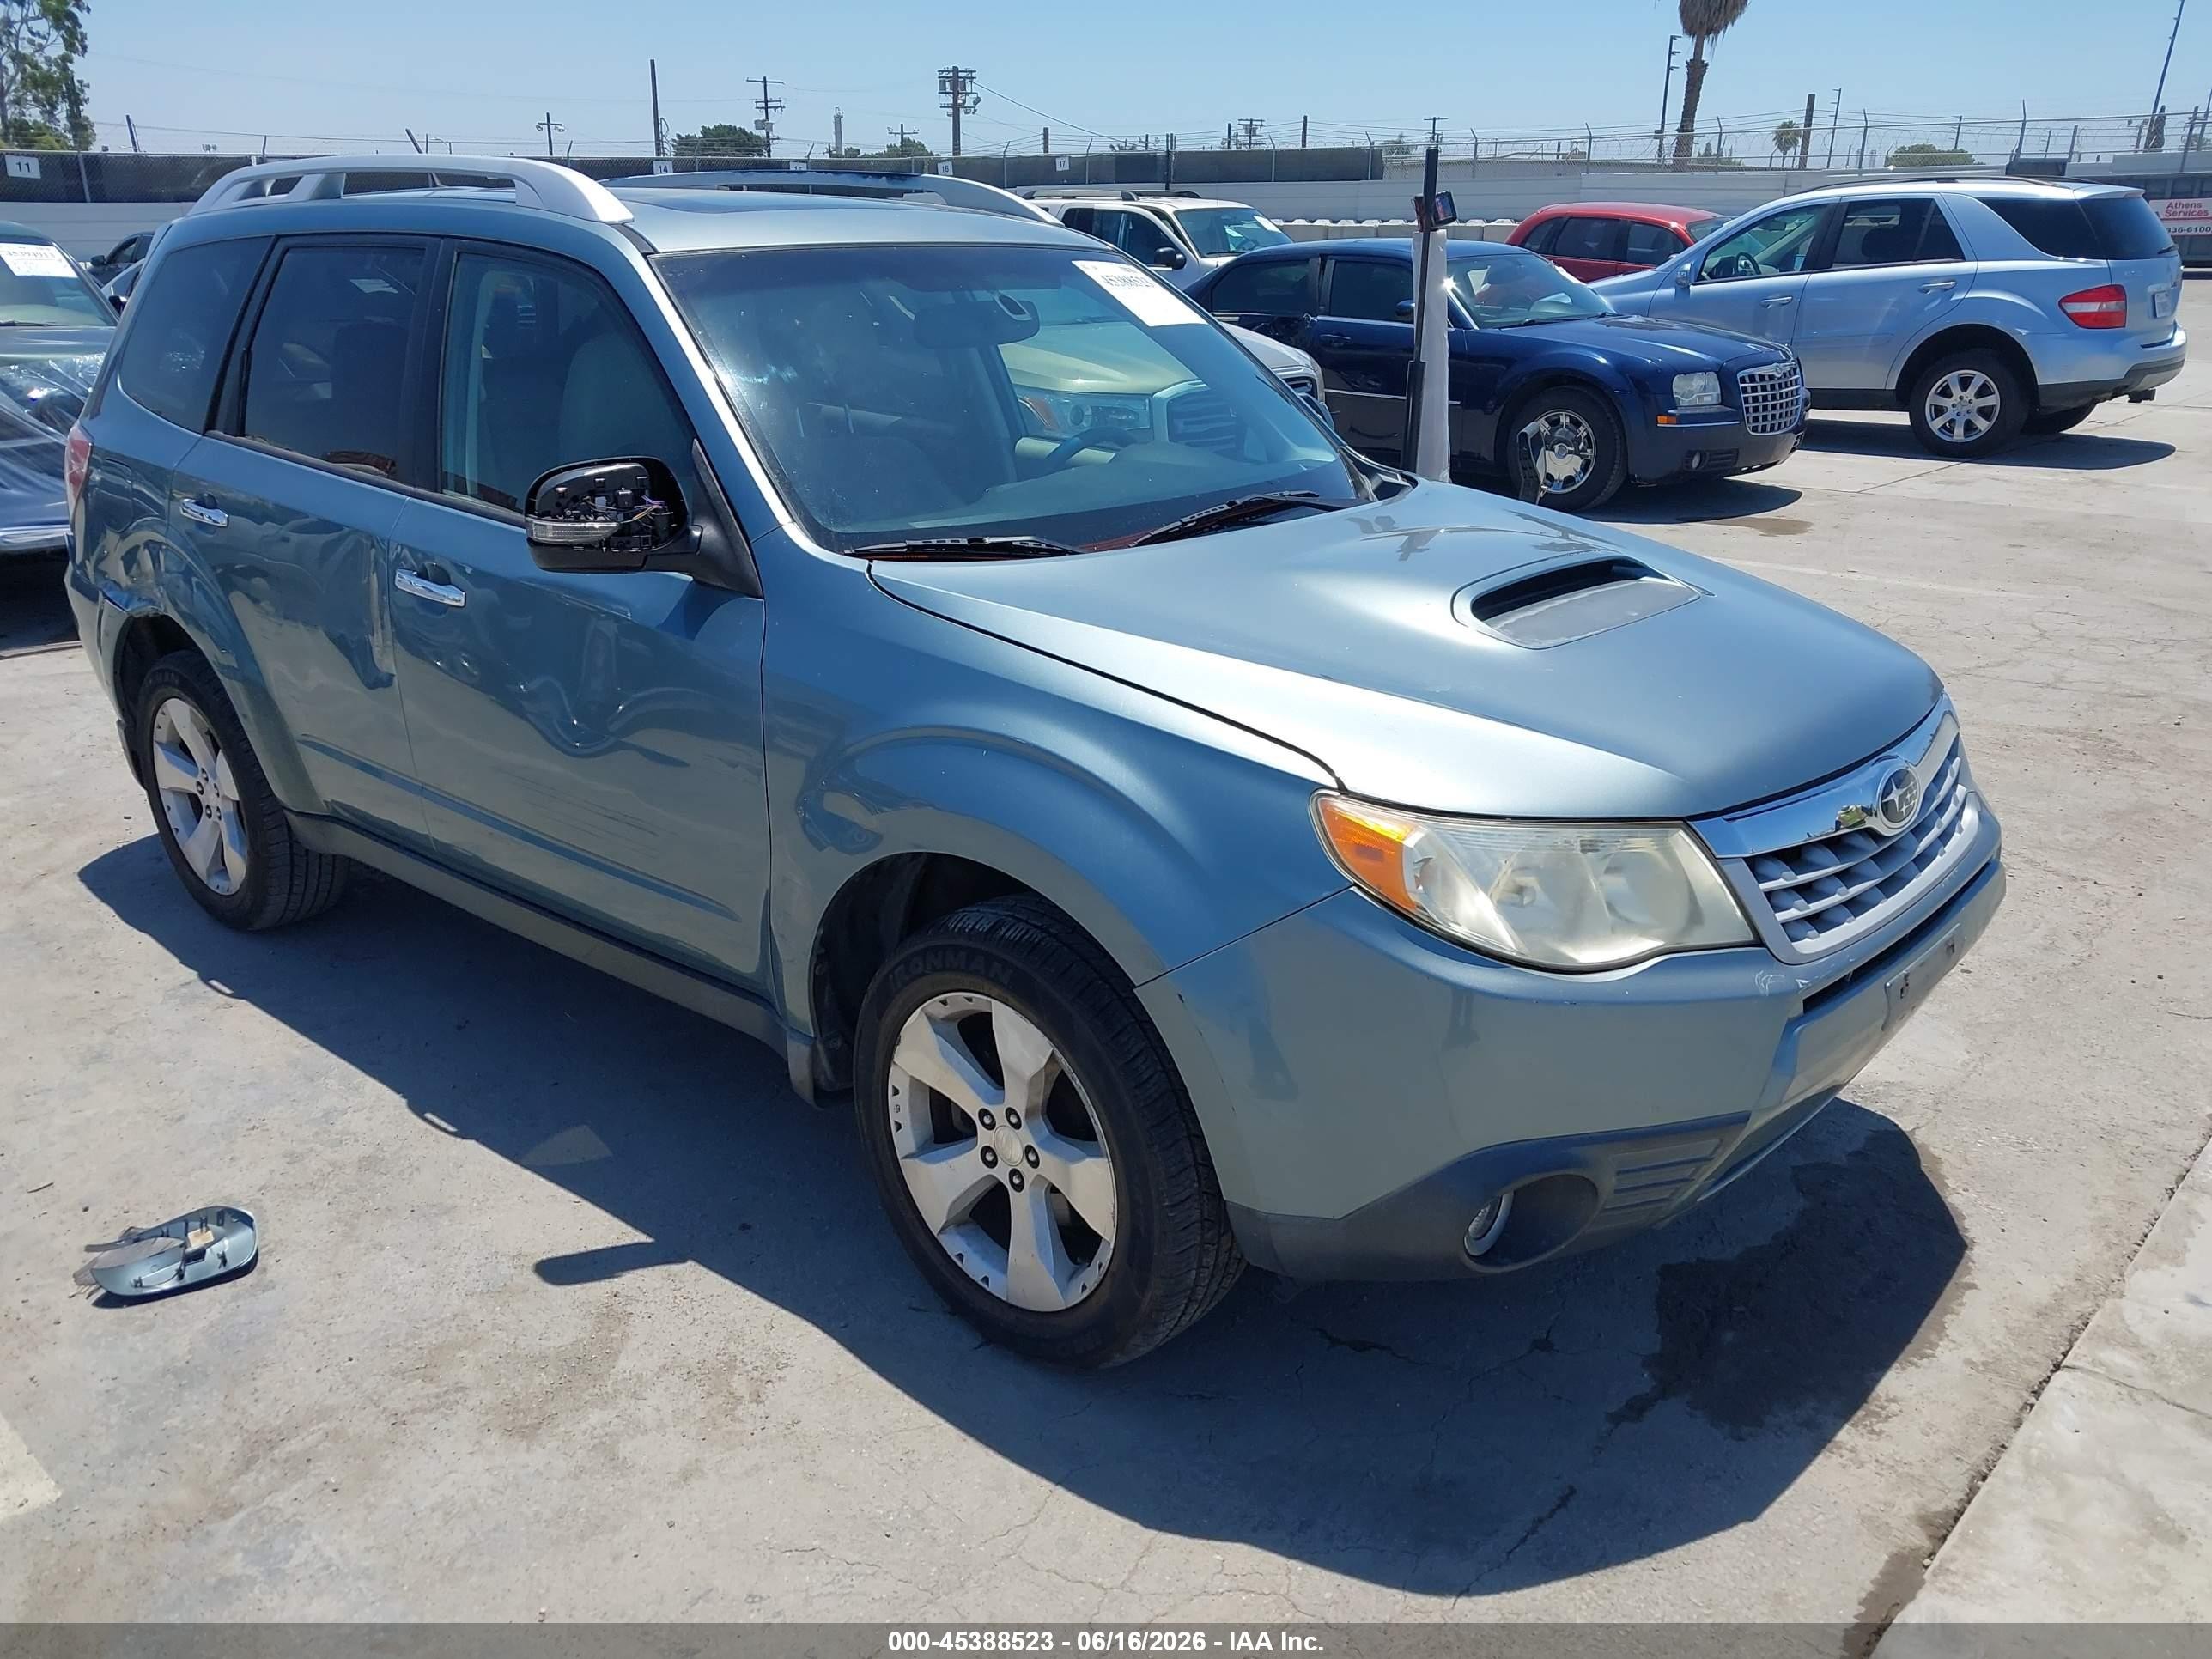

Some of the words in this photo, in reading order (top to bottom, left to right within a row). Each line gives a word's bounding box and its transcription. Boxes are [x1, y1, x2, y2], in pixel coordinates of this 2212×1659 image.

[15, 161, 31, 173] 11
[659, 165, 668, 173] 14
[2166, 201, 2203, 210] Athens
[2165, 209, 2209, 217] Services
